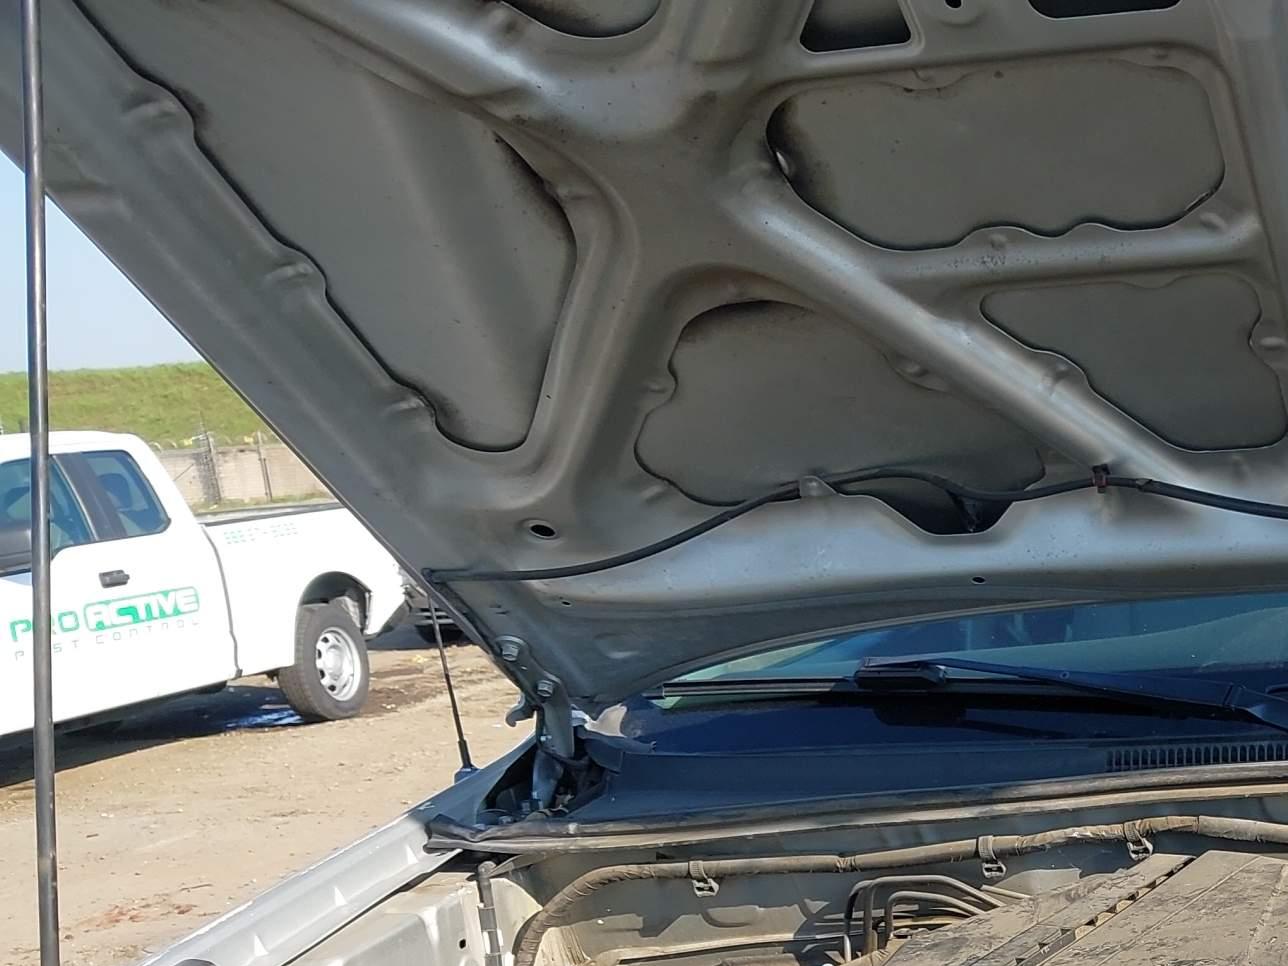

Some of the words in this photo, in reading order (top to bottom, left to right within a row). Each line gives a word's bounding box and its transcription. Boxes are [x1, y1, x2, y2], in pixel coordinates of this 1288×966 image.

[9, 611, 80, 642] PO
[86, 588, 199, 630] ACTIVE
[15, 640, 79, 661] PST
